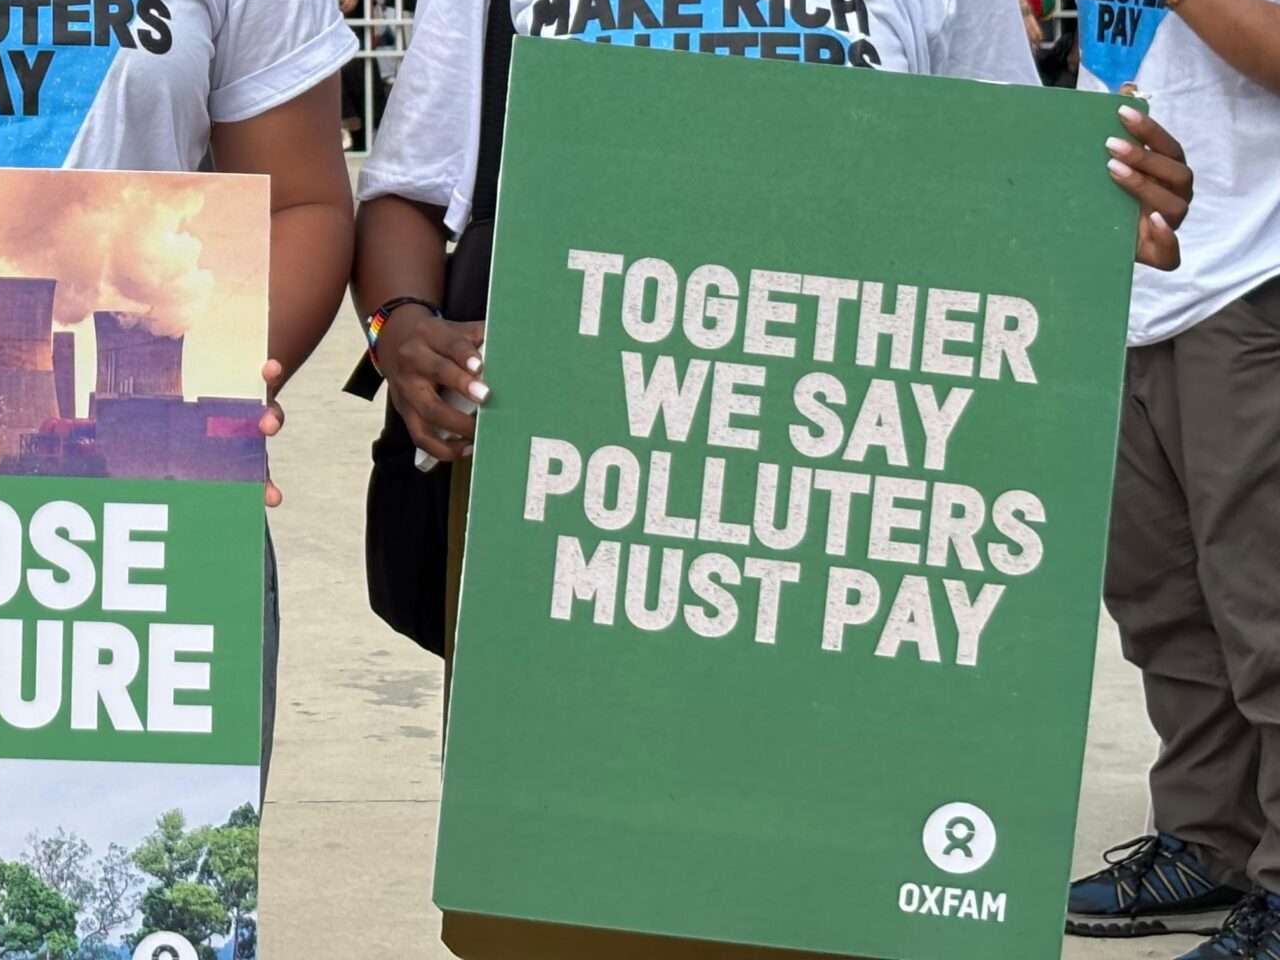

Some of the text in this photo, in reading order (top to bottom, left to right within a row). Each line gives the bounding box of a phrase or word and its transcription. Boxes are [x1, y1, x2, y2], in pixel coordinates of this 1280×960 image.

[1097, 3, 1143, 48] PAY
[567, 248, 1040, 385] TOGETHER
[620, 350, 976, 471] WE SAY
[522, 436, 1048, 576] POLLUTERS
[549, 534, 1008, 667] MUST PAY
[898, 882, 1008, 923] OXFAM
